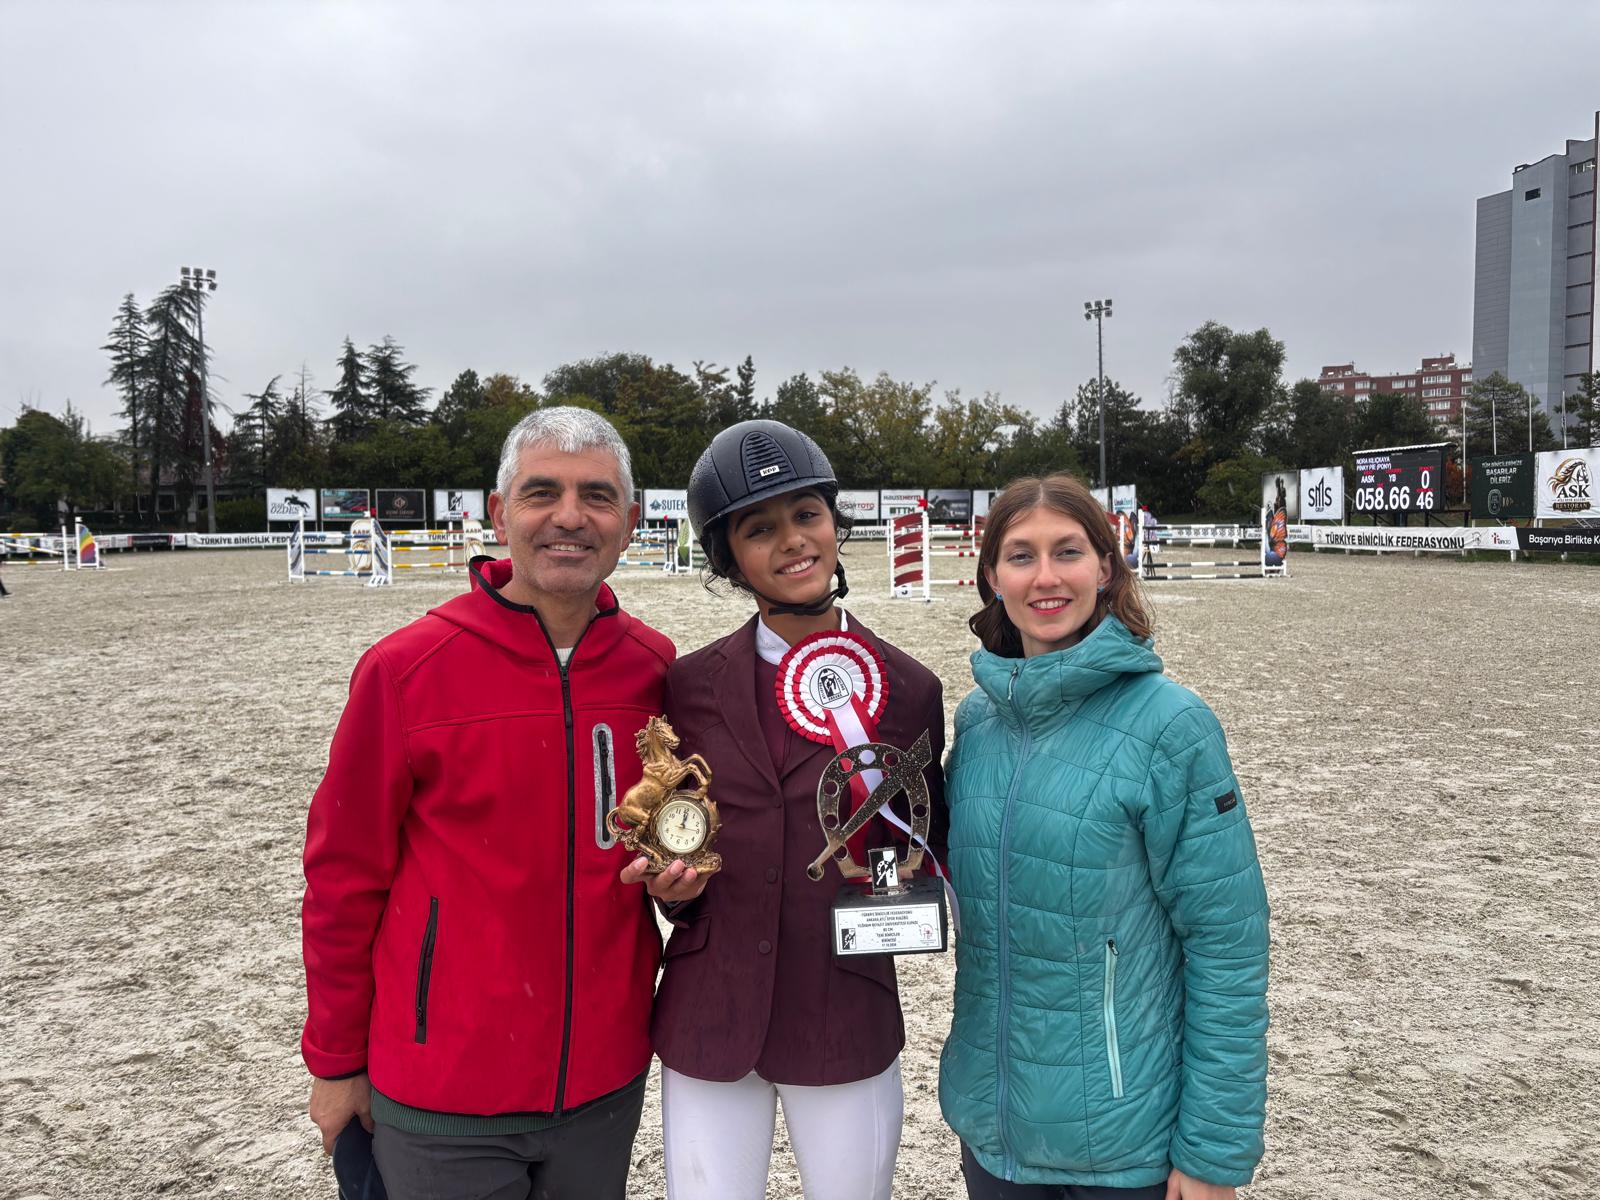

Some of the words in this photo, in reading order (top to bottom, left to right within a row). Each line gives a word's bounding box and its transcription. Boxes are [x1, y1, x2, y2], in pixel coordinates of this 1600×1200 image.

[1361, 475, 1375, 484] AASK
[1421, 470, 1430, 489] 0
[1557, 485, 1590, 498] ASK
[1355, 486, 1410, 511] 058.66
[1416, 491, 1434, 510] 46
[662, 500, 686, 511] SUTEK
[201, 536, 232, 544] TÜRKİYE
[1325, 532, 1356, 545] TÜRKİYE
[1358, 532, 1394, 546] BİNİCİLİK
[1396, 536, 1465, 549] FEDERASYONU
[1529, 534, 1563, 546] Başarıya
[1564, 535, 1592, 545] Birlikte
